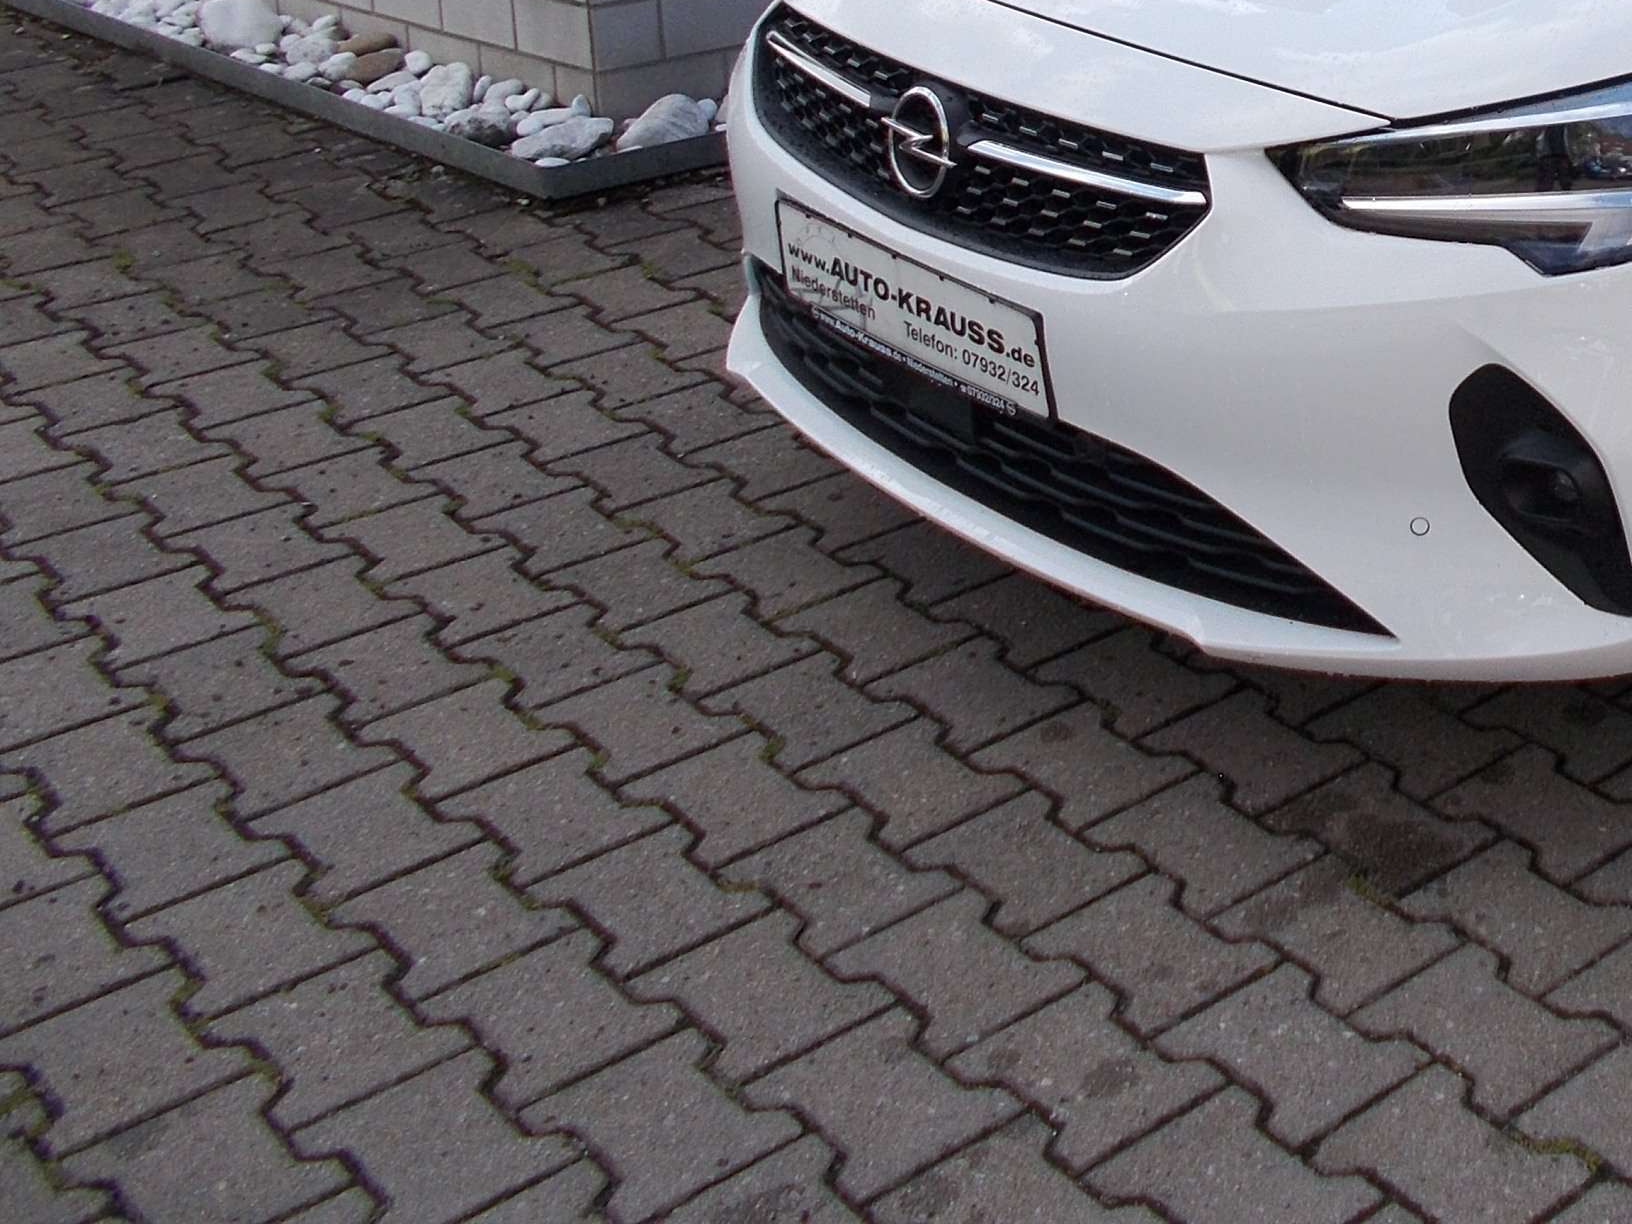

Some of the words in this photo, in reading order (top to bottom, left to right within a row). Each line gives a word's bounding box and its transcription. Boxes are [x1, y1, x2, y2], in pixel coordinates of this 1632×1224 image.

[788, 242, 1036, 369] www.AUTO-KRAUSS.de
[791, 264, 876, 321] Niederstetten
[903, 320, 959, 361] Telefon:
[962, 348, 1040, 396] 07932/324
